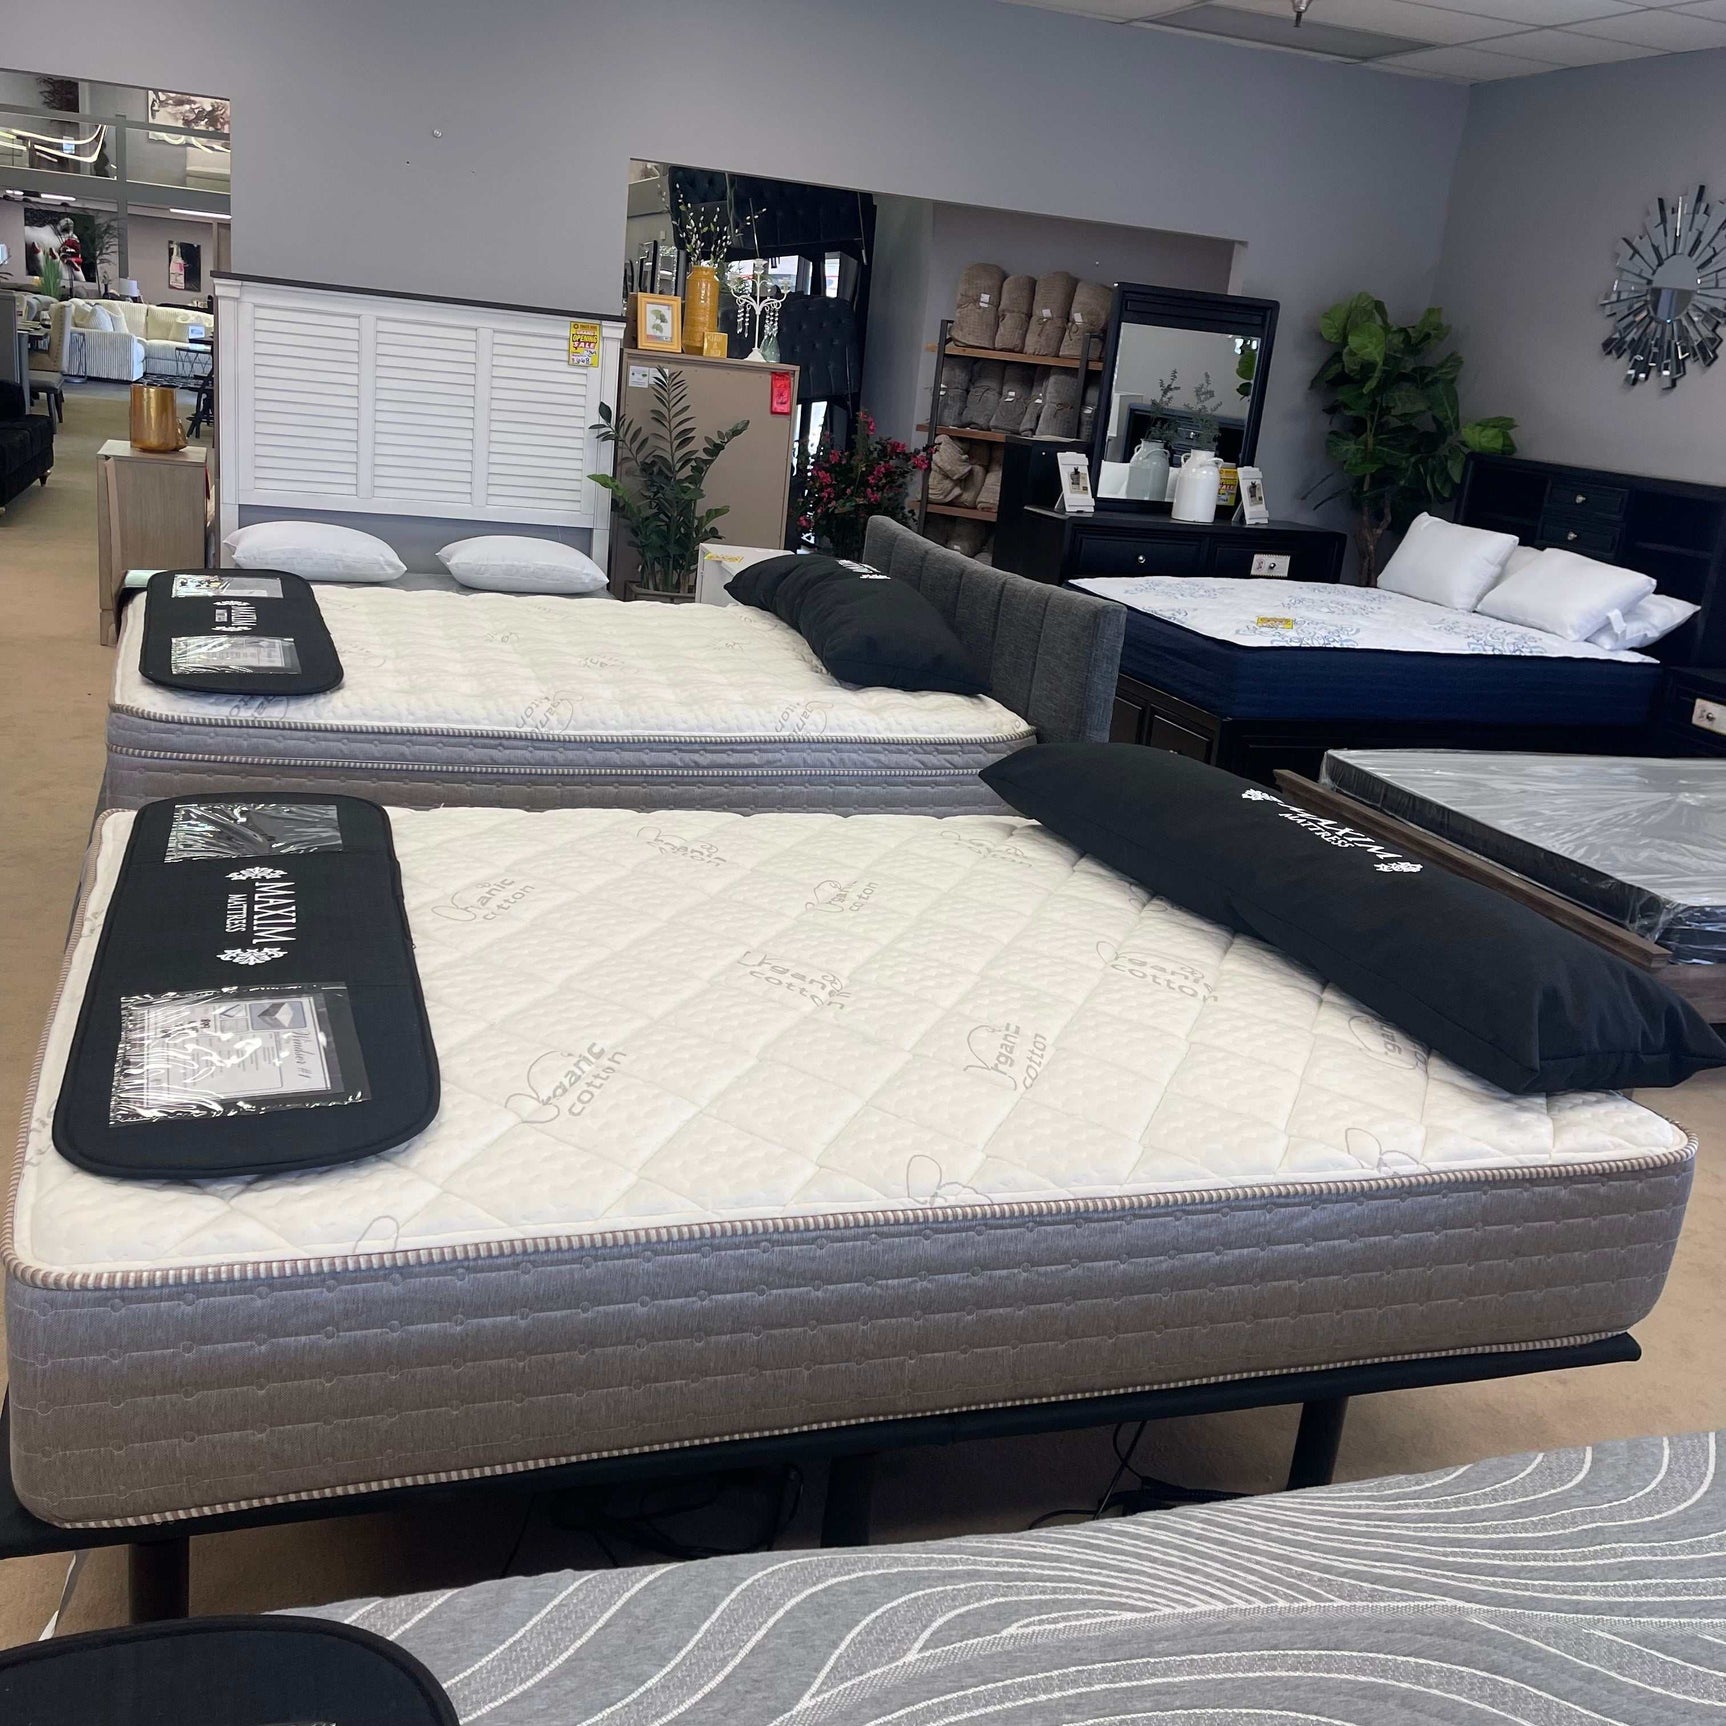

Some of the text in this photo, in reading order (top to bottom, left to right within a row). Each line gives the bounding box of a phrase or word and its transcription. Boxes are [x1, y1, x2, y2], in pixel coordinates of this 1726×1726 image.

[572, 333, 598, 343] OPENING
[573, 341, 596, 349] SALE
[1278, 801, 1402, 860] MAXIM
[1279, 813, 1355, 848] MATTRESS
[225, 893, 248, 933] MATTRESS
[252, 881, 297, 945] MAXIM
[1110, 964, 1219, 1003] cotton
[291, 1030, 316, 1066] Windsor
[568, 1051, 627, 1117] cotton
